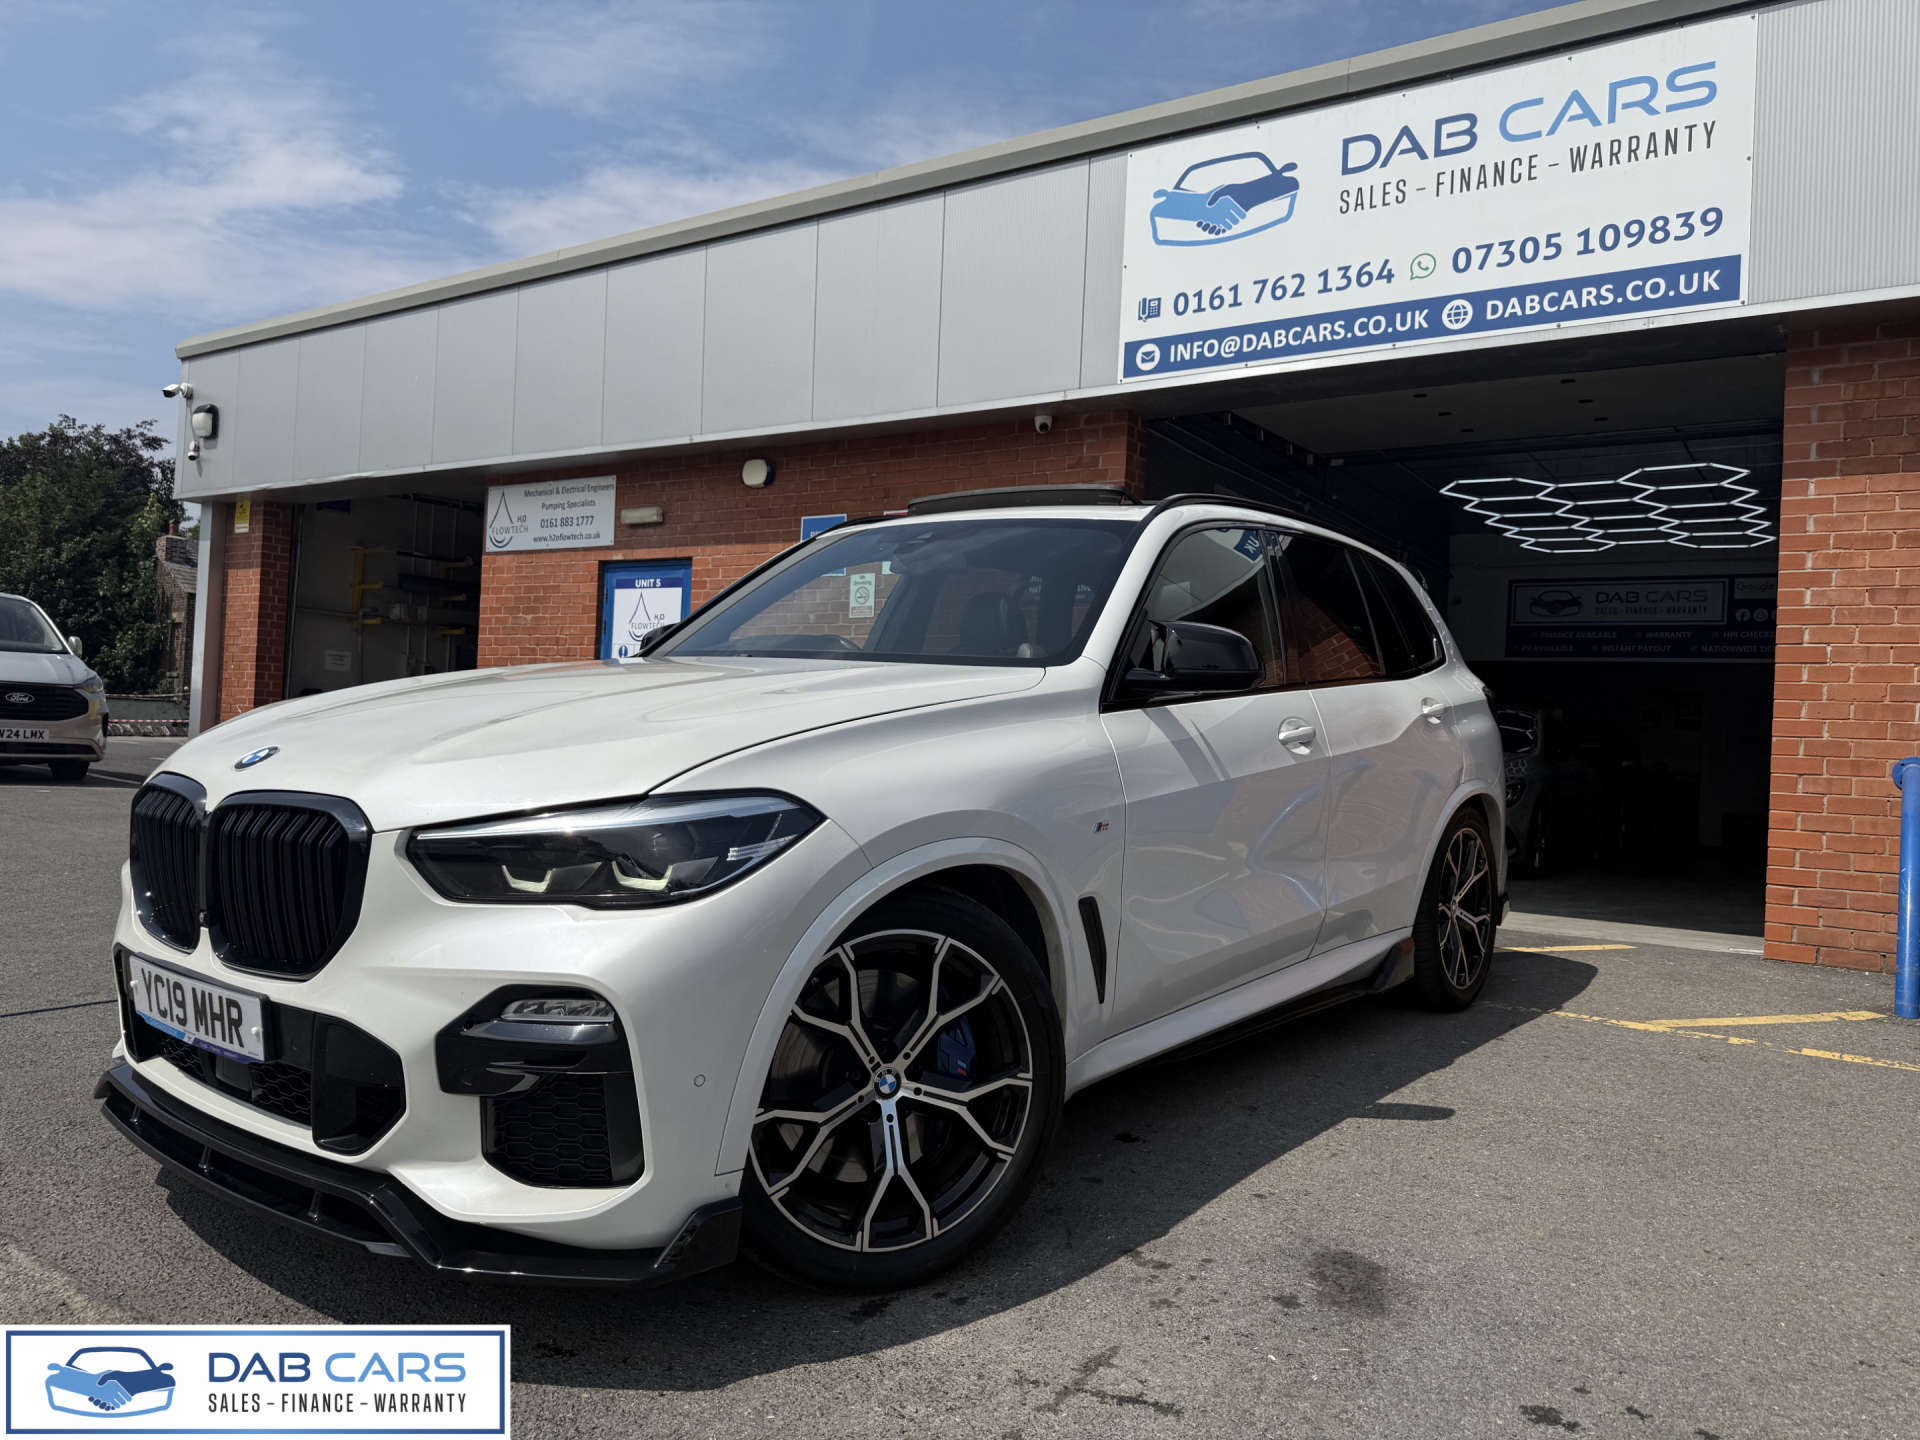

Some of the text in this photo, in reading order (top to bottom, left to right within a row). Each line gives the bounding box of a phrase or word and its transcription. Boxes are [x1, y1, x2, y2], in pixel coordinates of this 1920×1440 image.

[1341, 60, 1718, 176] DAB CARS
[1339, 178, 1407, 215] SALES
[1436, 154, 1539, 198] FINANCE
[1569, 120, 1717, 174] WARRANTY
[1452, 206, 1724, 274] 07305 109839
[1173, 259, 1395, 317] 0161 762 1364
[1485, 268, 1722, 321] DABCARS.CO.UK
[1169, 308, 1430, 364] INFO@DABCARS.CO.UK
[523, 487, 554, 498] Mechanical
[541, 502, 565, 511] Pumping
[491, 524, 529, 535] FLOWTECH
[540, 515, 595, 528] 0161 883 1777
[635, 578, 662, 588] UNIT 5
[1595, 589, 1709, 604] DAB CARS
[140, 967, 245, 1048] YC19 MHR
